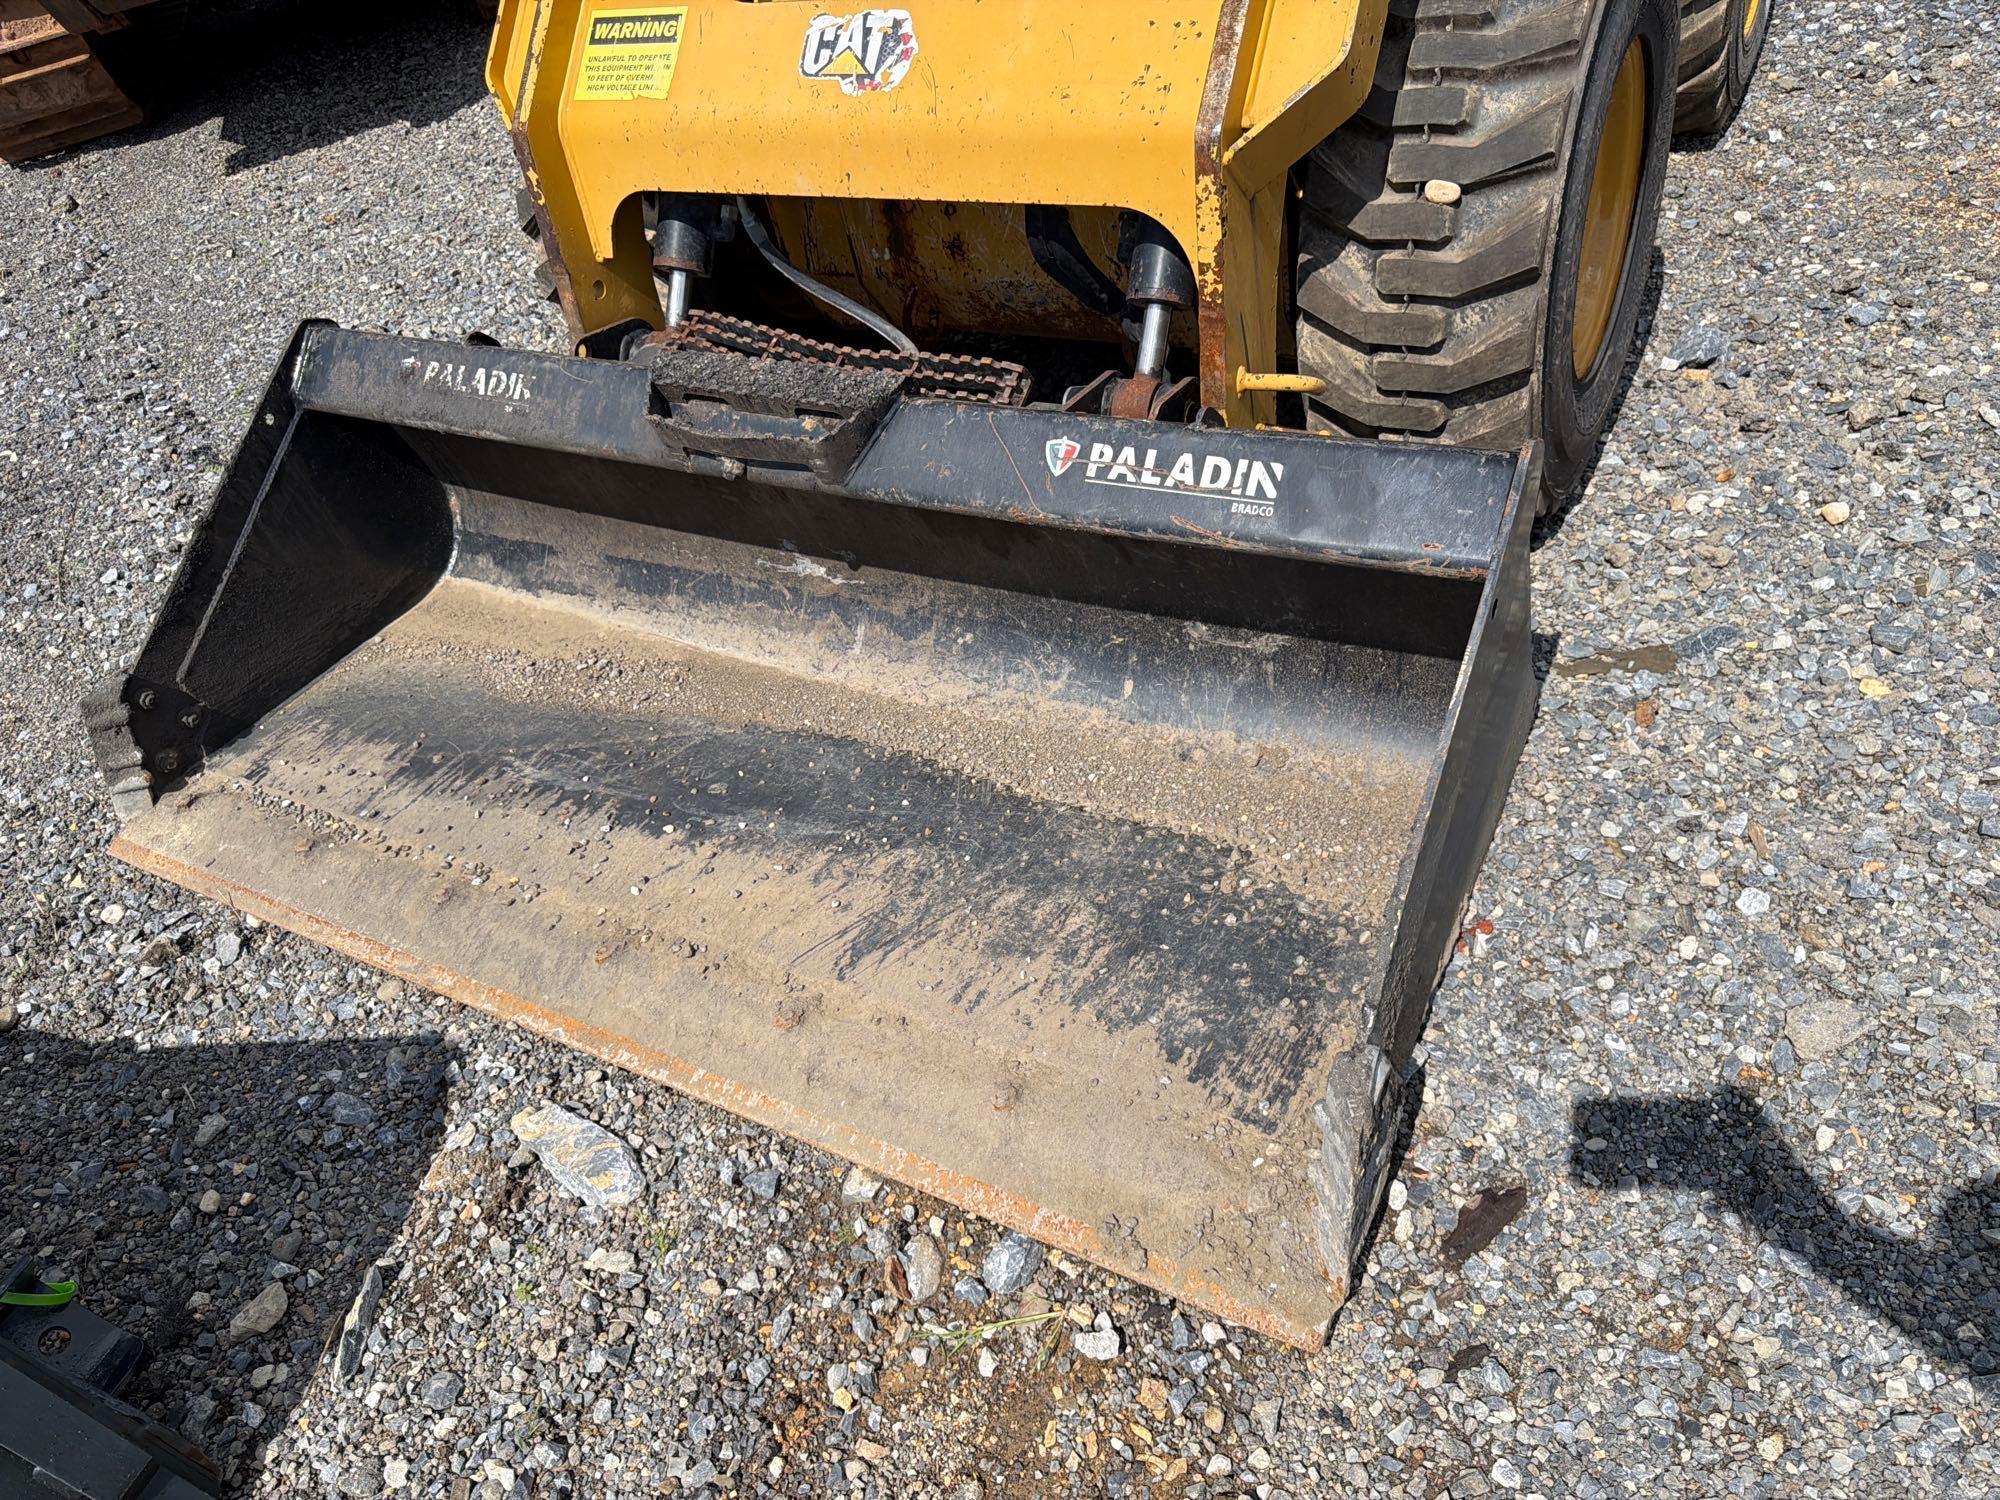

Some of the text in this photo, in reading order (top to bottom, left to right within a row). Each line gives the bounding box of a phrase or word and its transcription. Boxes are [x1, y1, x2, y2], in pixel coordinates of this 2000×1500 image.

[594, 20, 677, 40] WARNING
[801, 13, 896, 76] CAT
[1086, 443, 1284, 499] PALADIN
[1231, 502, 1274, 517] BRADCO
